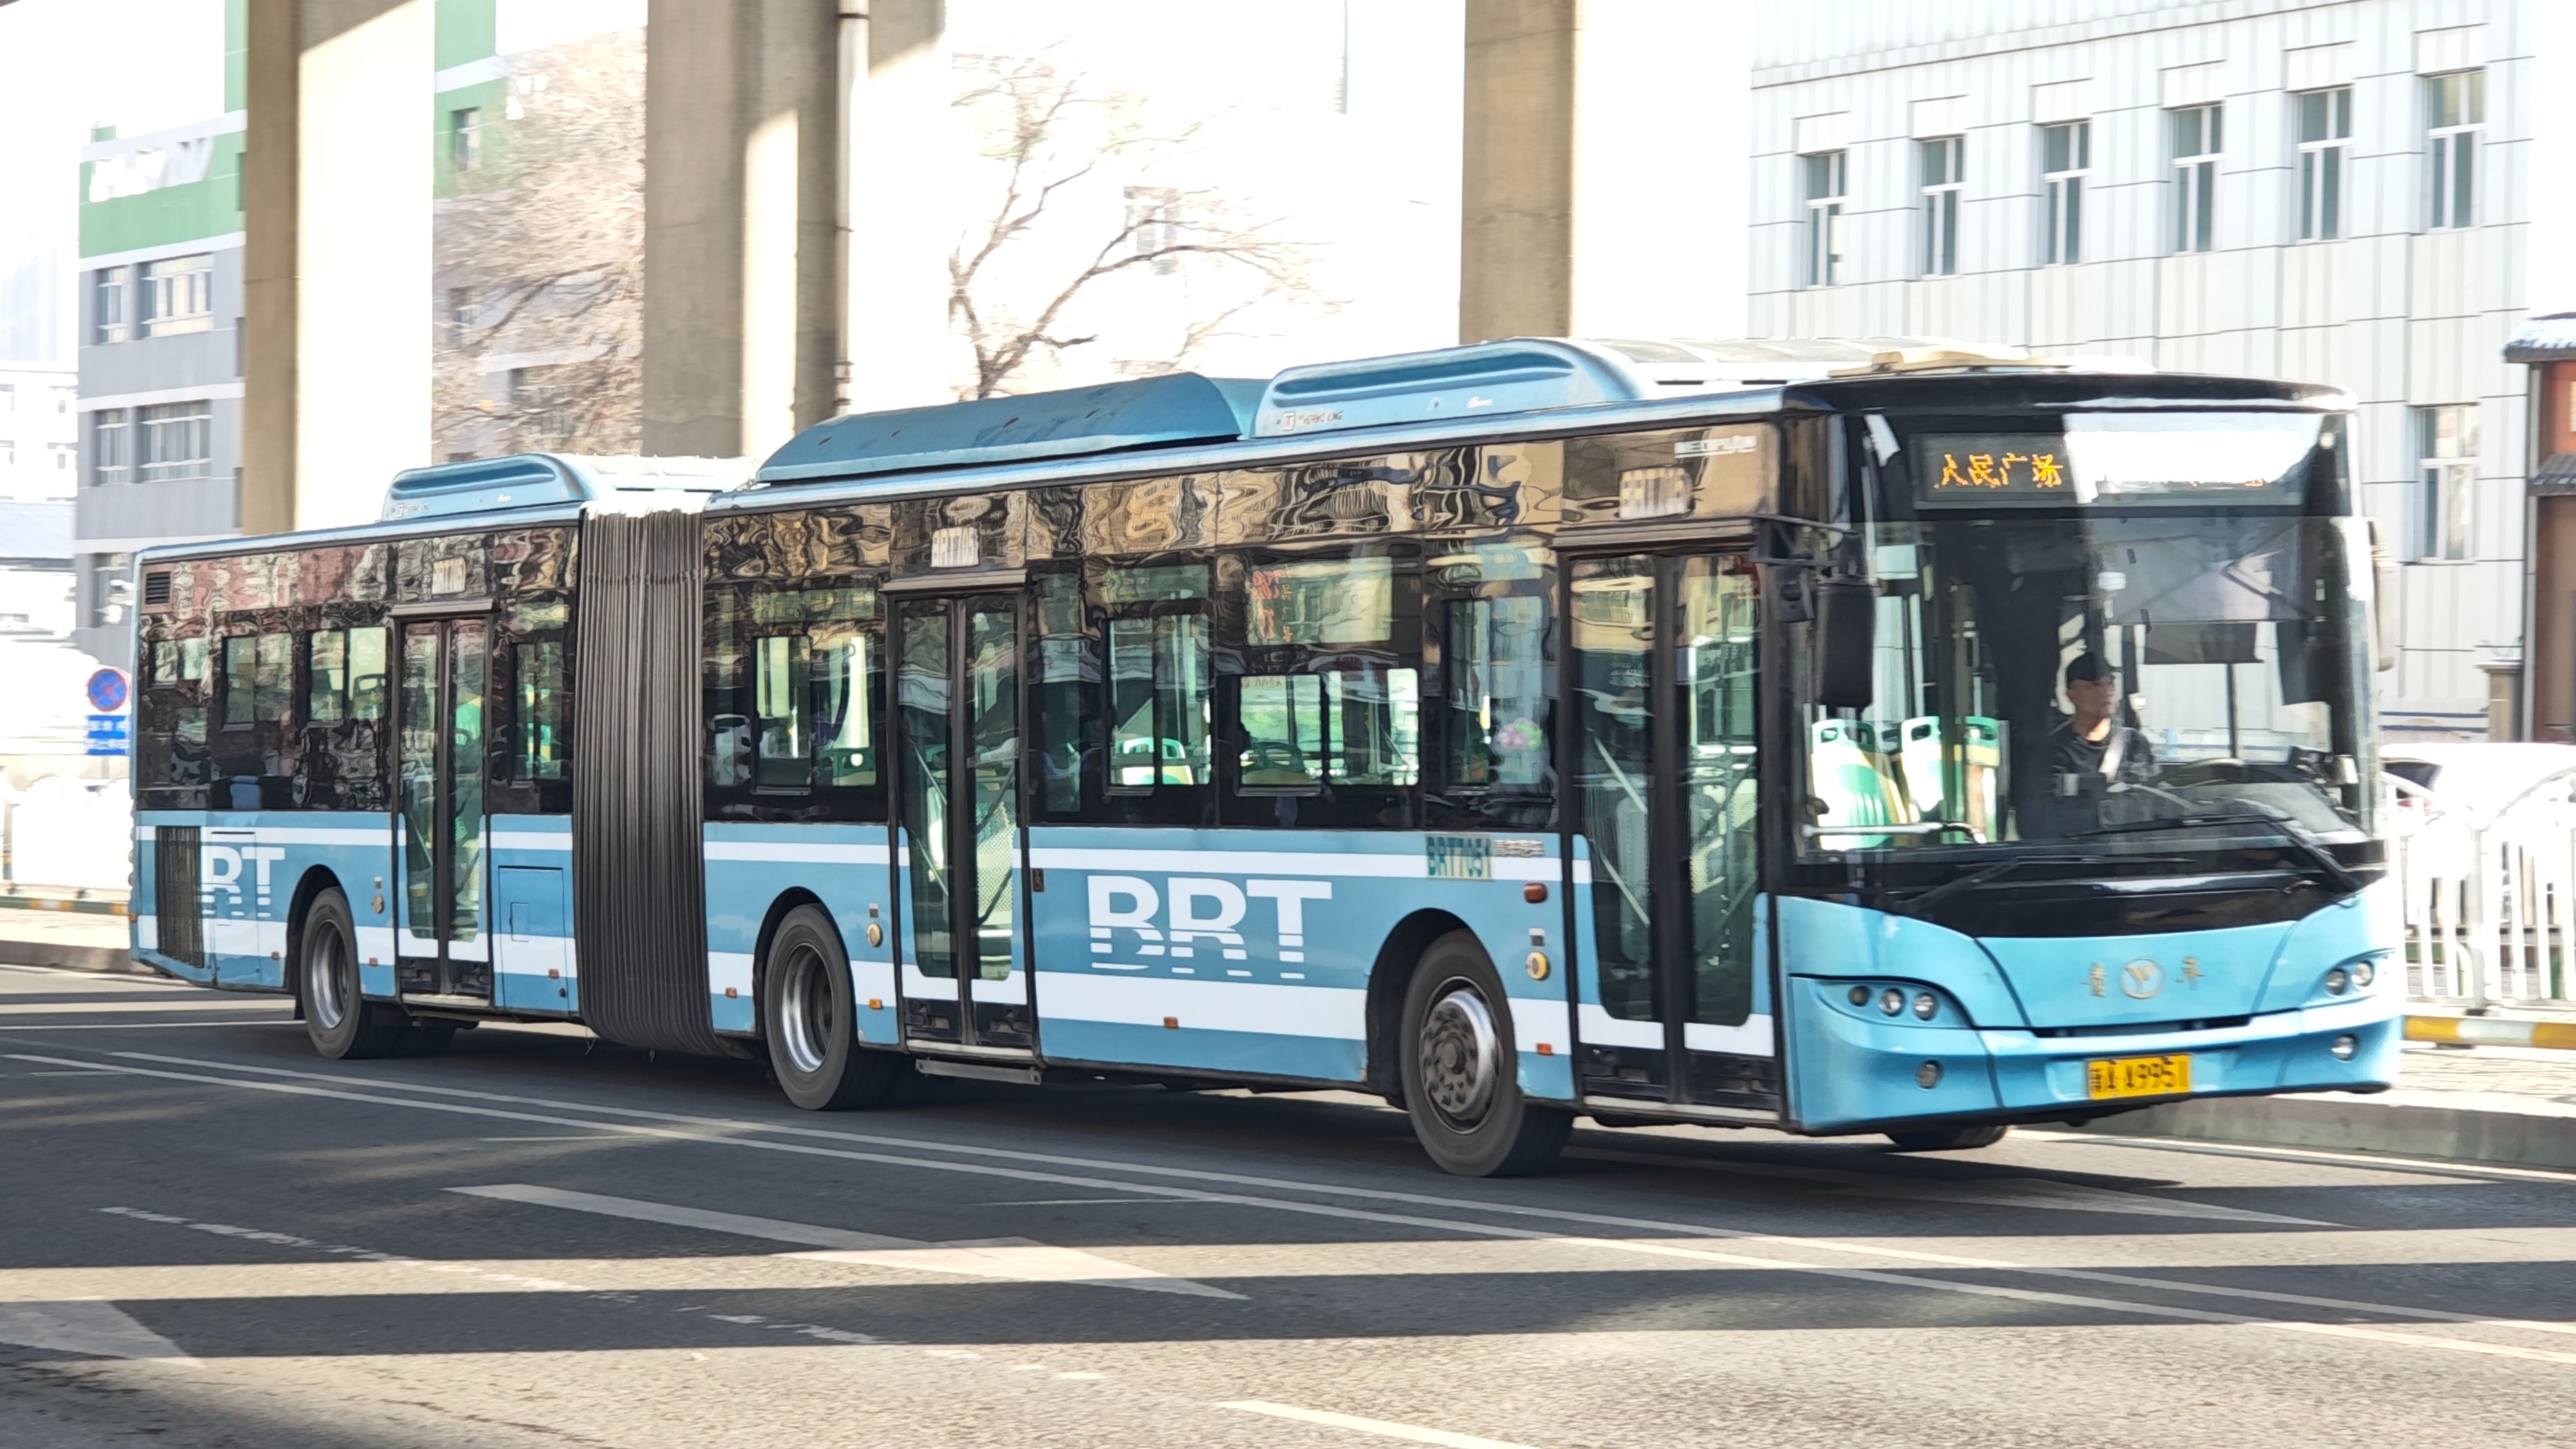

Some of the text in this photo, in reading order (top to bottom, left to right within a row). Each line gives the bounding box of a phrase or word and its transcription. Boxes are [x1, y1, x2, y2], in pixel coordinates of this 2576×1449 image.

[1941, 452, 2064, 489] 人民广场
[1088, 875, 1332, 980] BRT
